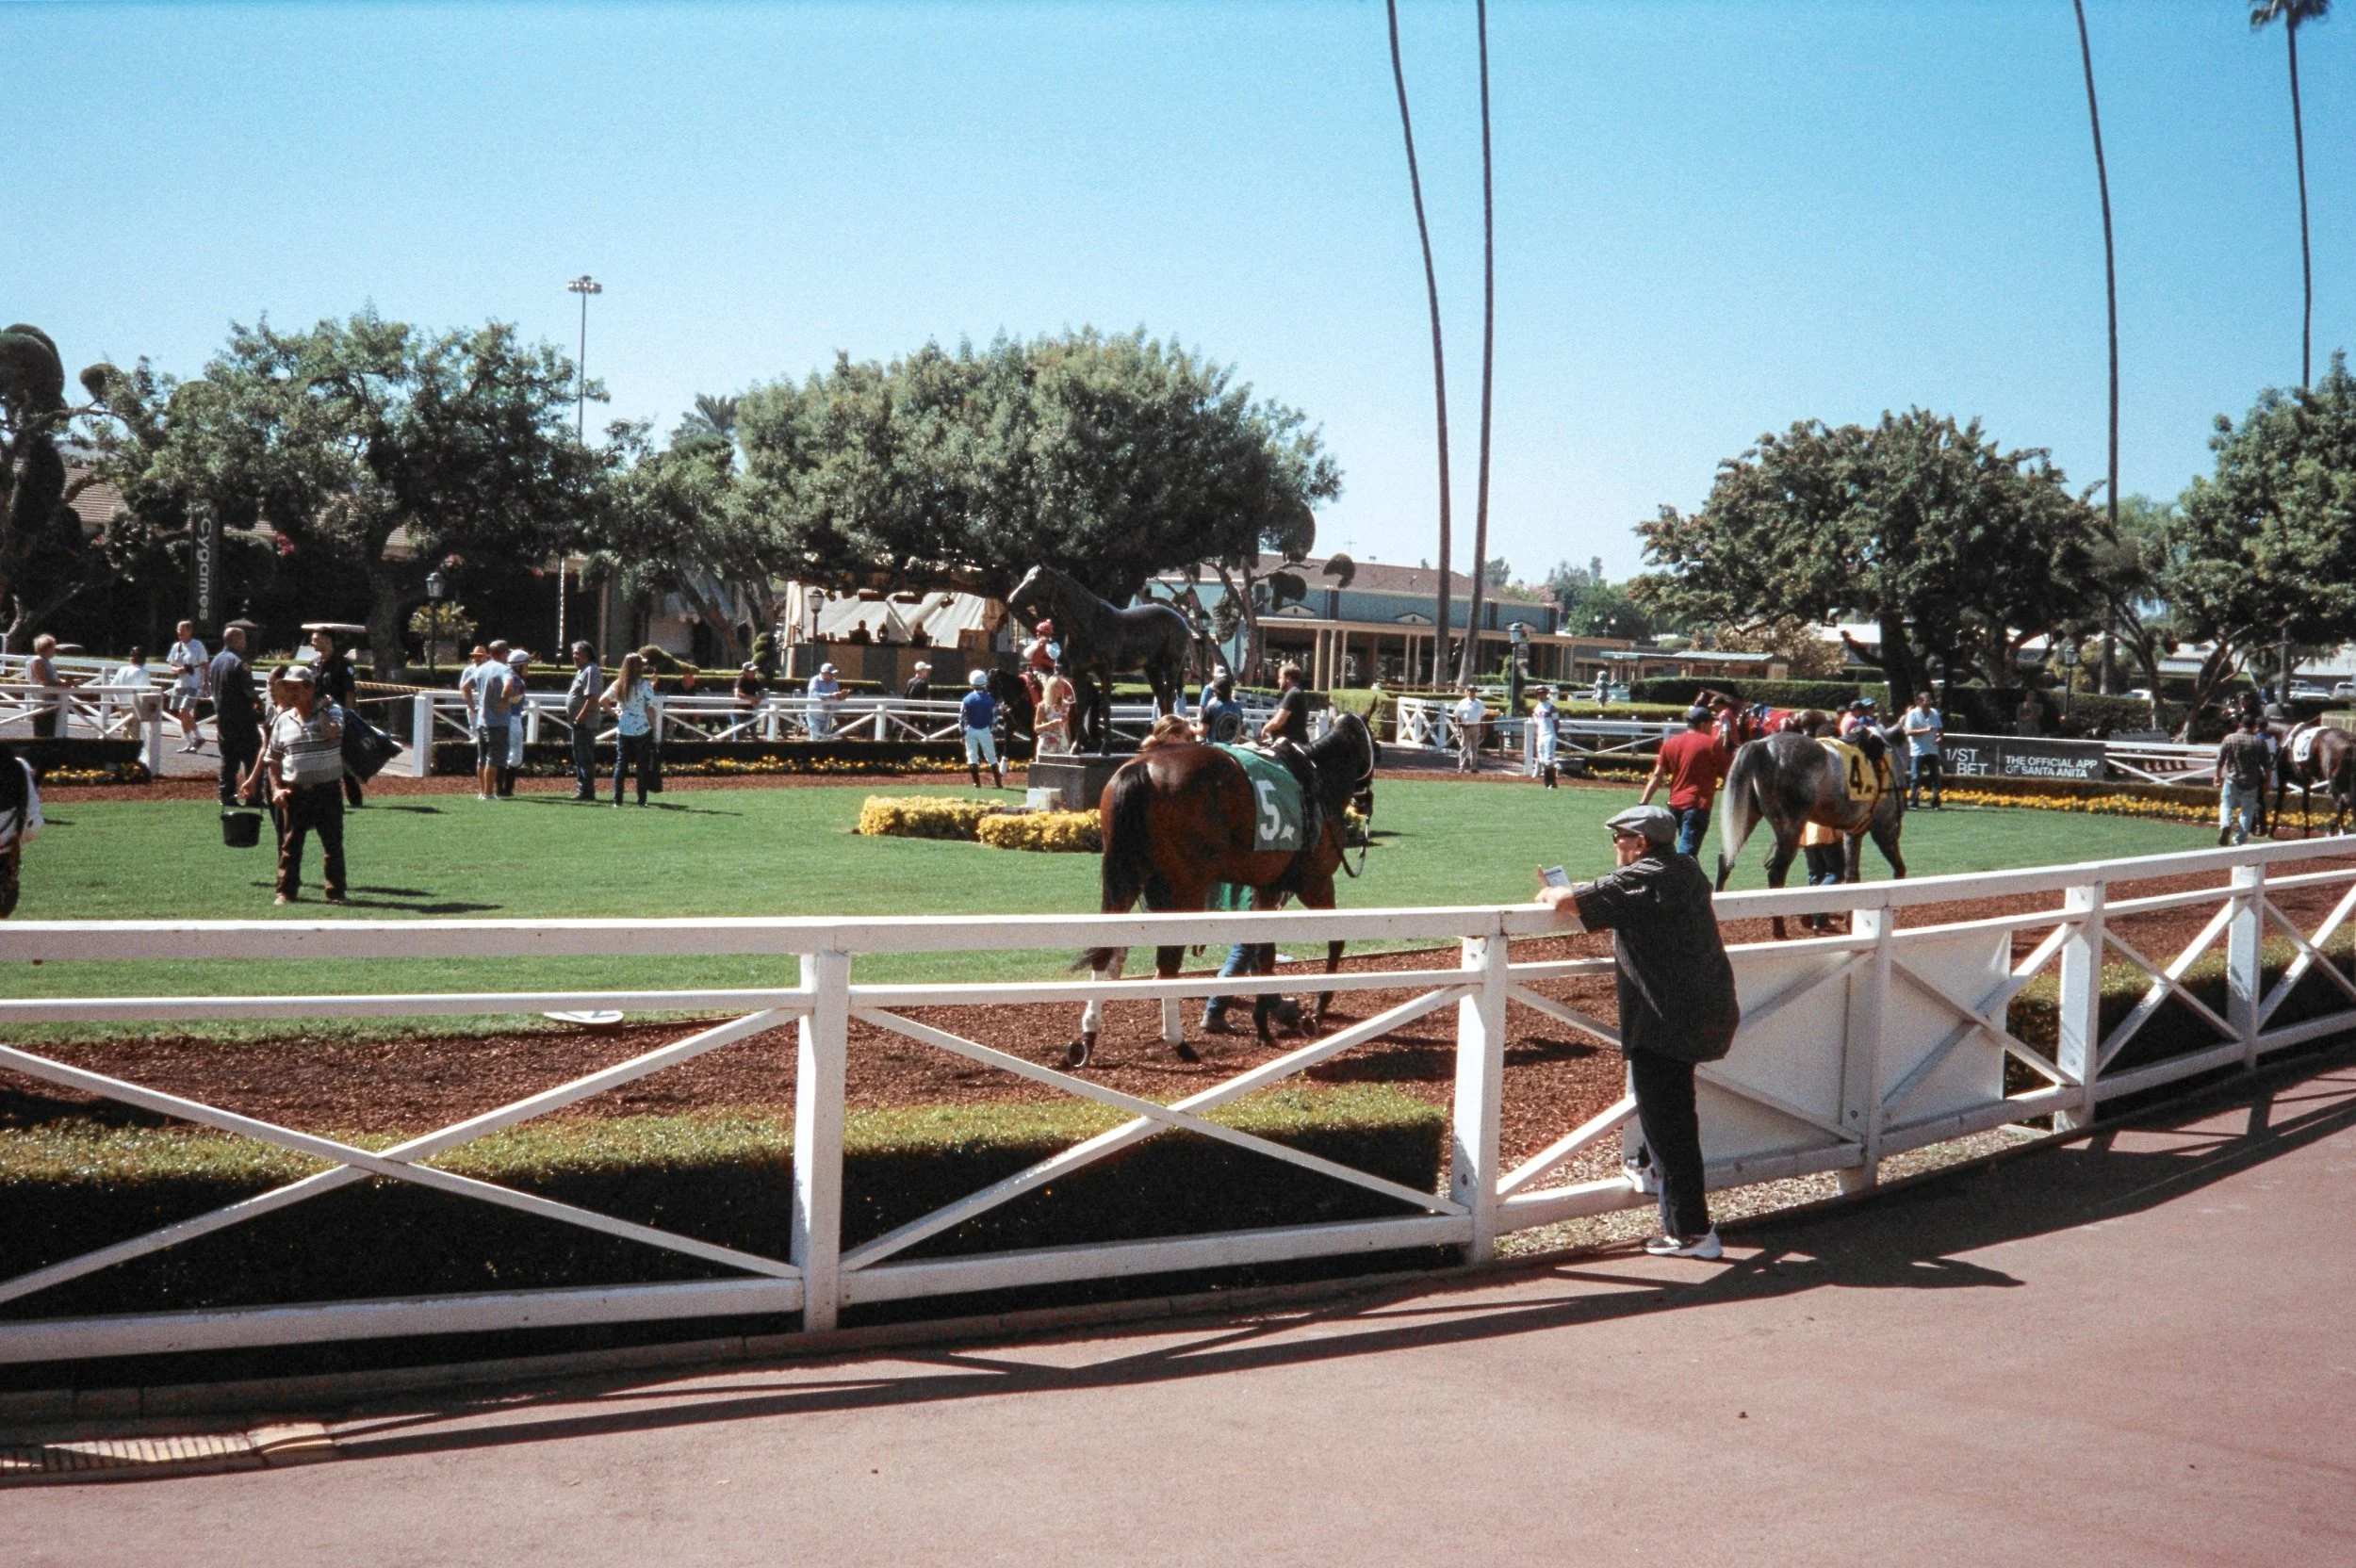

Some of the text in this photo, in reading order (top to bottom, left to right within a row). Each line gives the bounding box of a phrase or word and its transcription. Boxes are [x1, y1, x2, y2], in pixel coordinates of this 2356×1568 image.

[196, 517, 212, 620] Cygames
[1945, 747, 1979, 762] 1/ST
[2005, 755, 2098, 769] THE OFFICIAL APP
[1849, 755, 1862, 794] 4
[1956, 761, 1989, 776] BET
[2004, 764, 2088, 778] OF SANTA ANITA
[1255, 779, 1281, 841] 5
